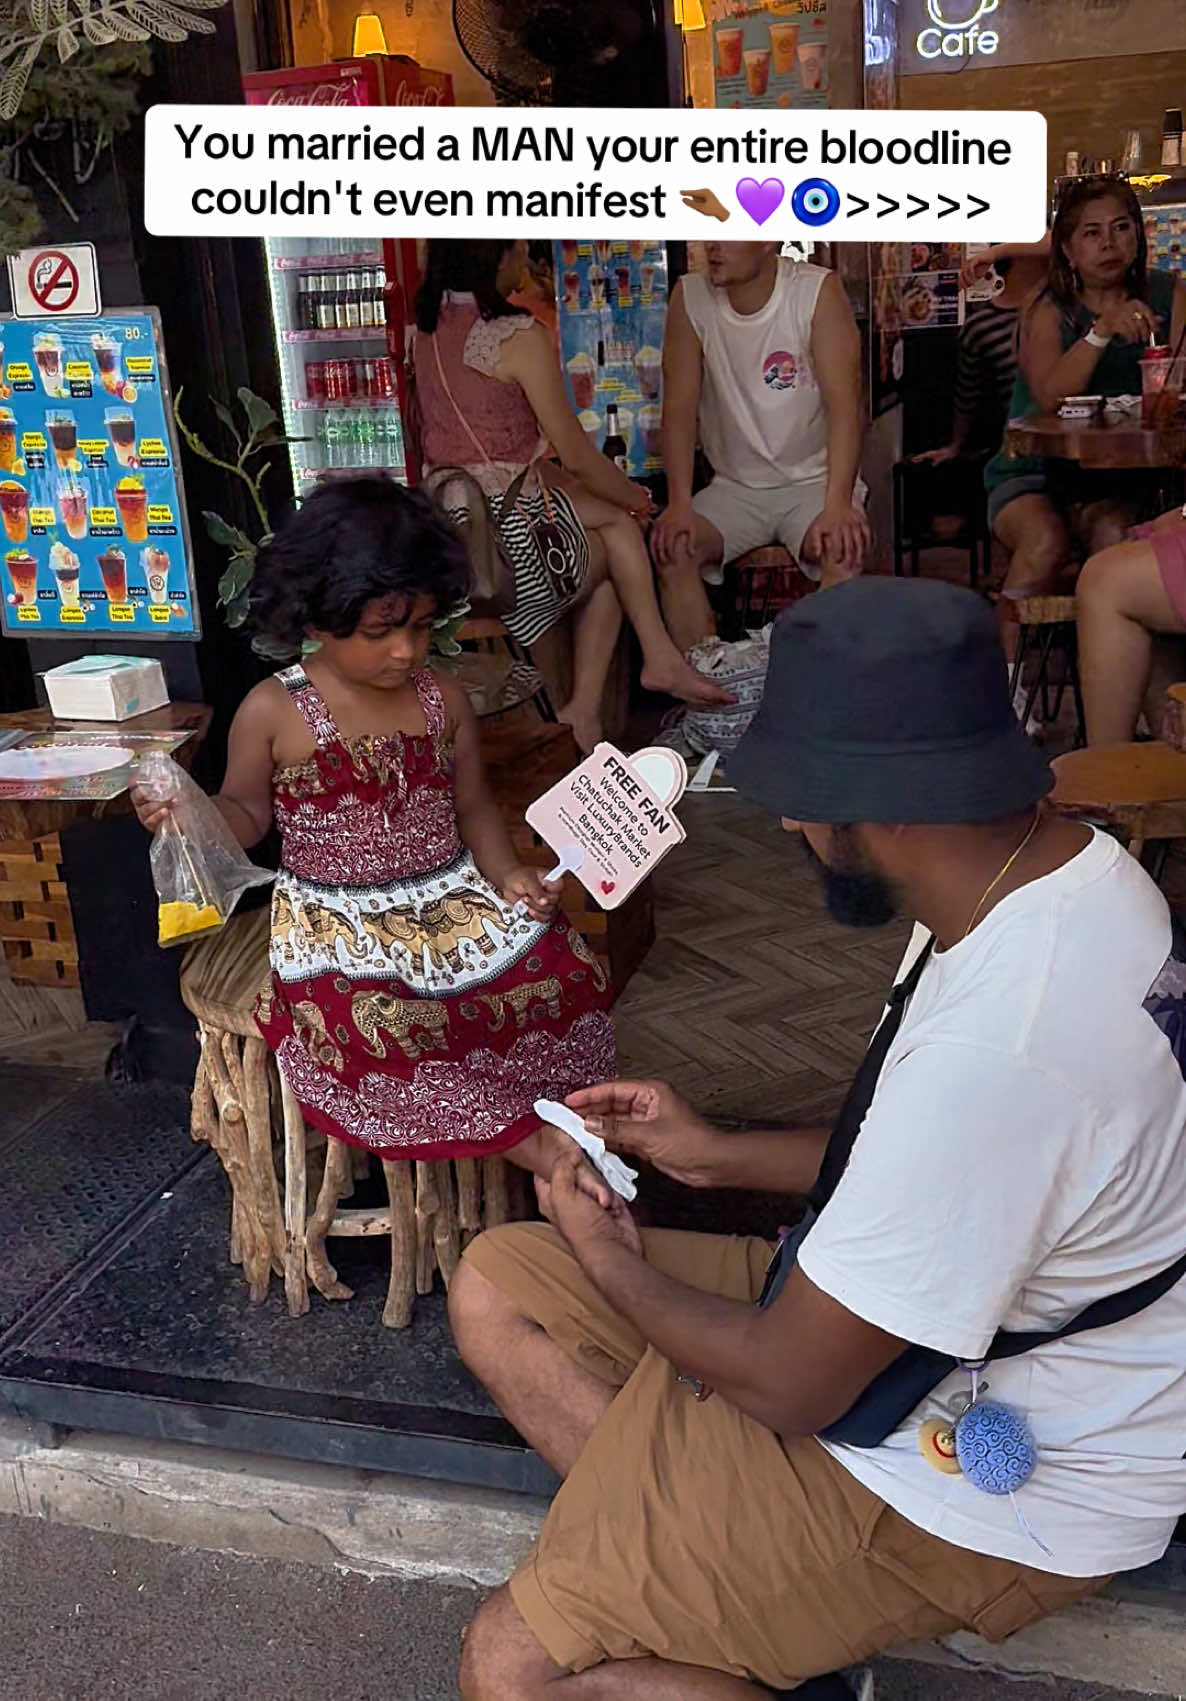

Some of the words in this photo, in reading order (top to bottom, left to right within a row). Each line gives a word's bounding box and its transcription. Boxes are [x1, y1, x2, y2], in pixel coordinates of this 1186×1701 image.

[916, 23, 1000, 59] Cafe
[570, 781, 590, 806] Visit
[578, 773, 623, 826] Chatuchak
[621, 823, 651, 860] Market
[599, 776, 639, 824] Welcome
[637, 821, 650, 837] to
[602, 755, 643, 800] FREE
[637, 797, 672, 835] FAN
[578, 813, 614, 857] Bangkok
